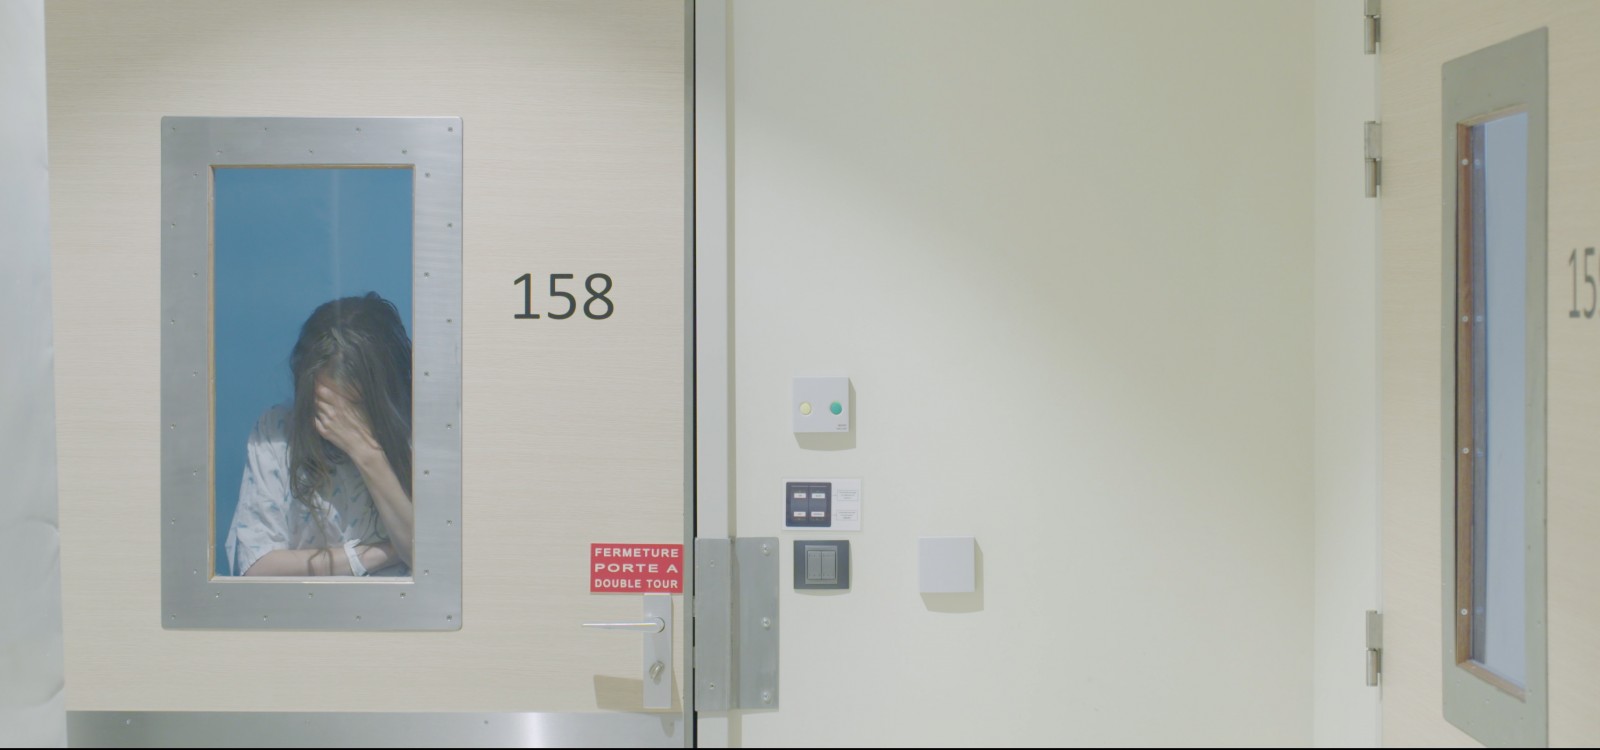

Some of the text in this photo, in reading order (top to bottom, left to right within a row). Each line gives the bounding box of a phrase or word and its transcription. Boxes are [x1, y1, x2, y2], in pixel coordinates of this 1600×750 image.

[1568, 247, 1600, 319] 15
[513, 273, 614, 320] 158
[594, 547, 679, 558] FERMETURE
[594, 563, 679, 573] PORTE A
[594, 578, 679, 589] DOUBLE TOUR
